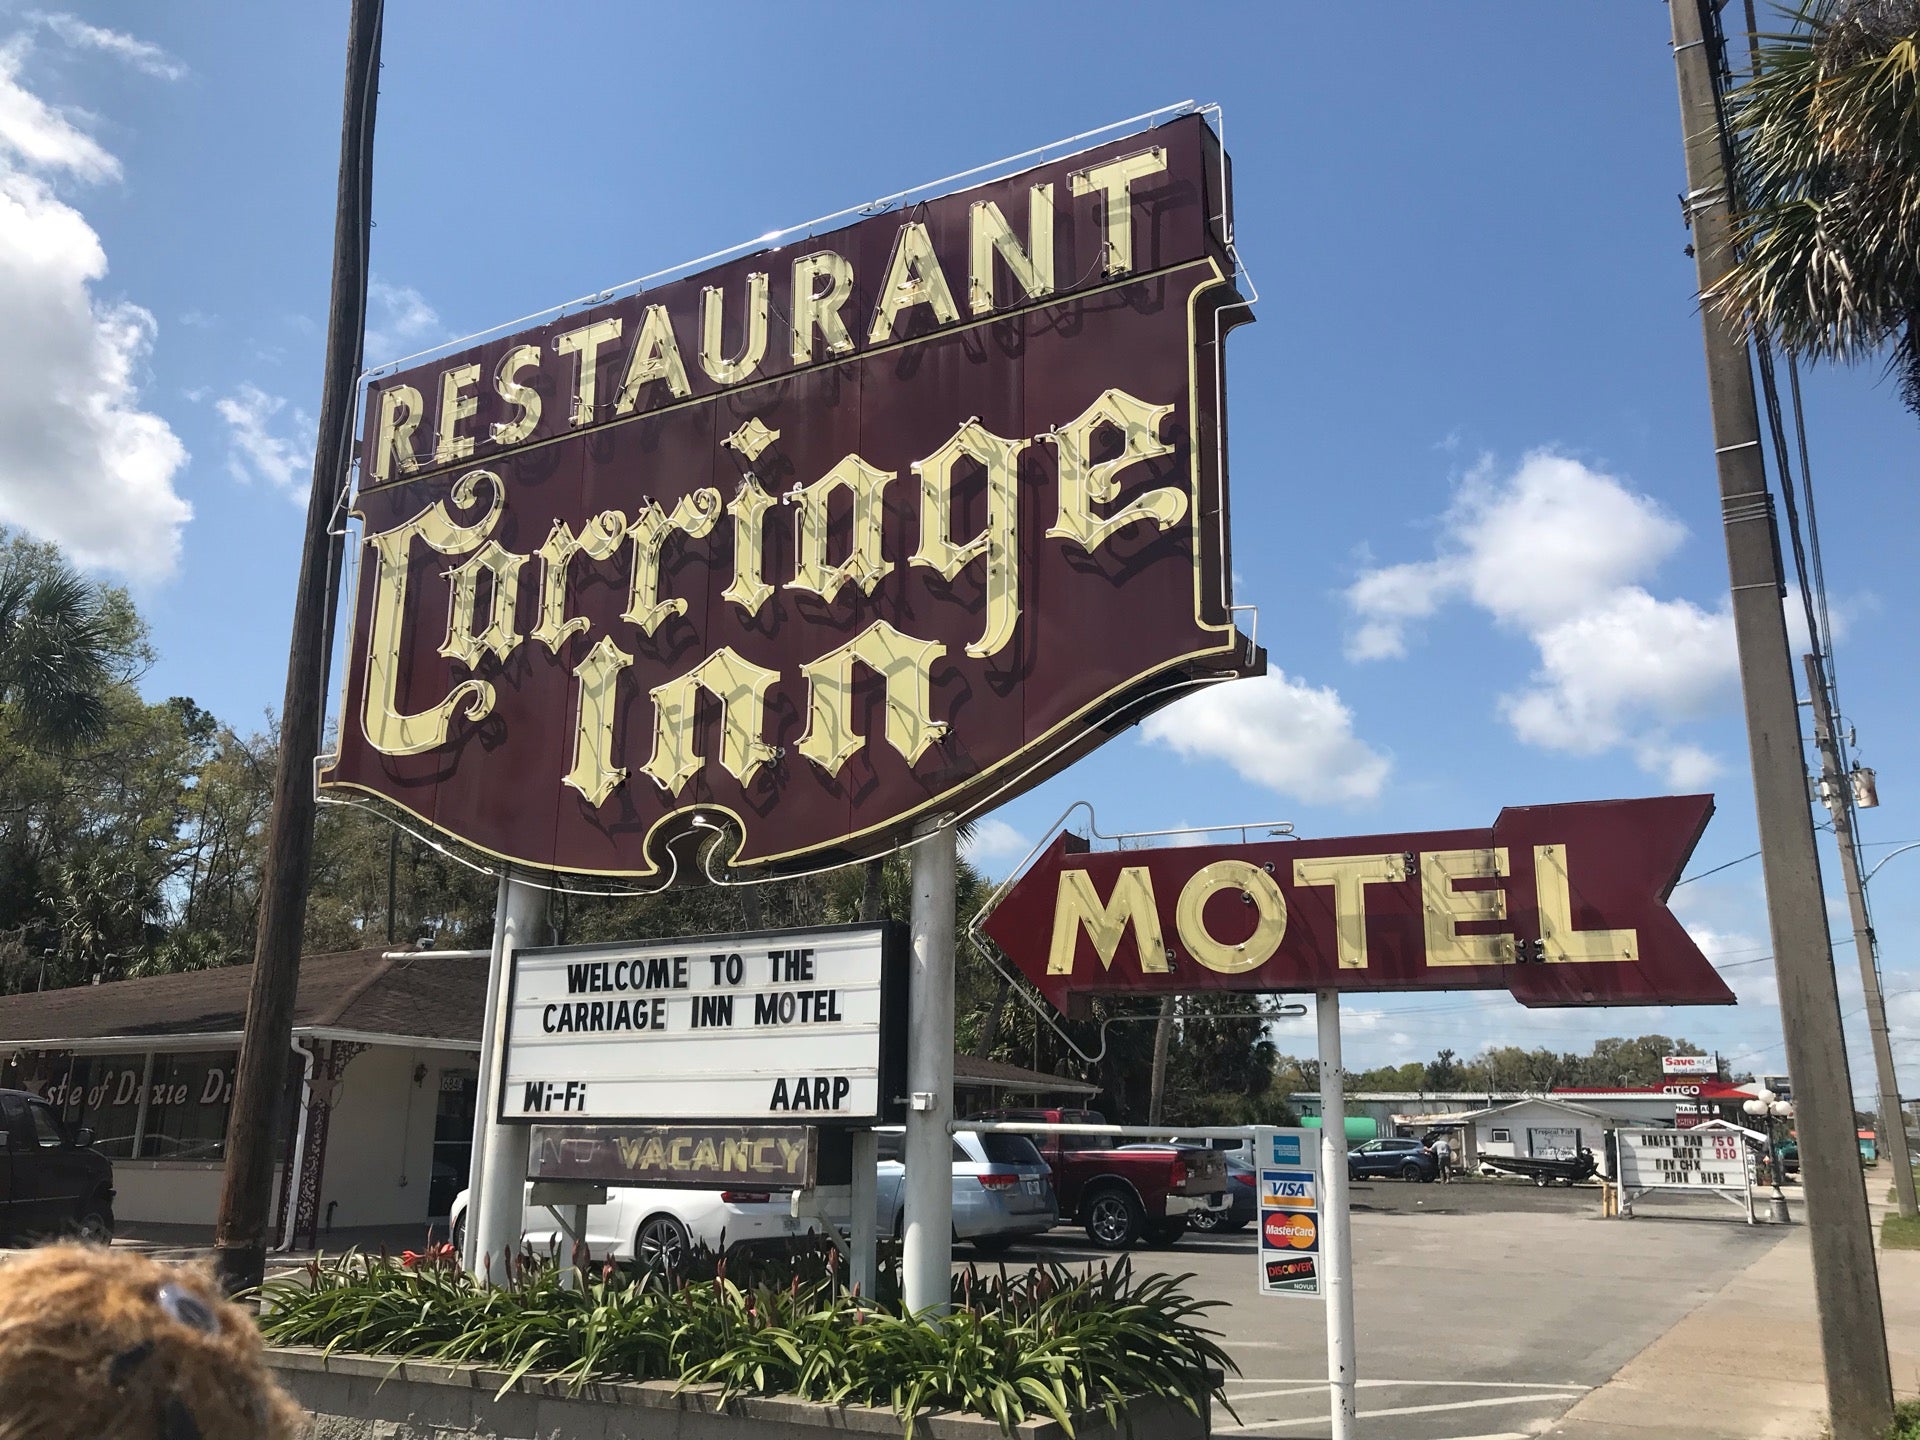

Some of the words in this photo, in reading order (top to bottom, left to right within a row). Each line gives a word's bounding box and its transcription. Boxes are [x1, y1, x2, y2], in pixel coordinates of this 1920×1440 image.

[371, 145, 1168, 482] RESTAURANT
[360, 388, 1190, 755] Carriage
[562, 618, 949, 808] Inn
[1046, 843, 1639, 976] MOTEL
[566, 956, 688, 994] WELCOME
[709, 953, 743, 987] TO
[767, 948, 815, 982] THE
[542, 997, 666, 1034] CARRIAGE
[691, 994, 734, 1029] INN
[754, 989, 842, 1026] MOTEL
[1665, 1057, 1695, 1066] Save
[47, 1072, 84, 1106] ste
[88, 1070, 113, 1111] of
[523, 1080, 587, 1112] Wi-Fi
[769, 1076, 851, 1111] AARP
[1662, 1085, 1700, 1095] CITGO
[614, 1136, 807, 1174] VACANCY
[1711, 1136, 1735, 1147] 750
[1680, 1159, 1702, 1171] CHX
[1271, 1181, 1306, 1197] VISA
[1265, 1224, 1315, 1238] MasterCard
[1267, 1261, 1312, 1277] DISCOVER
[1293, 1283, 1315, 1291] NOVUS
